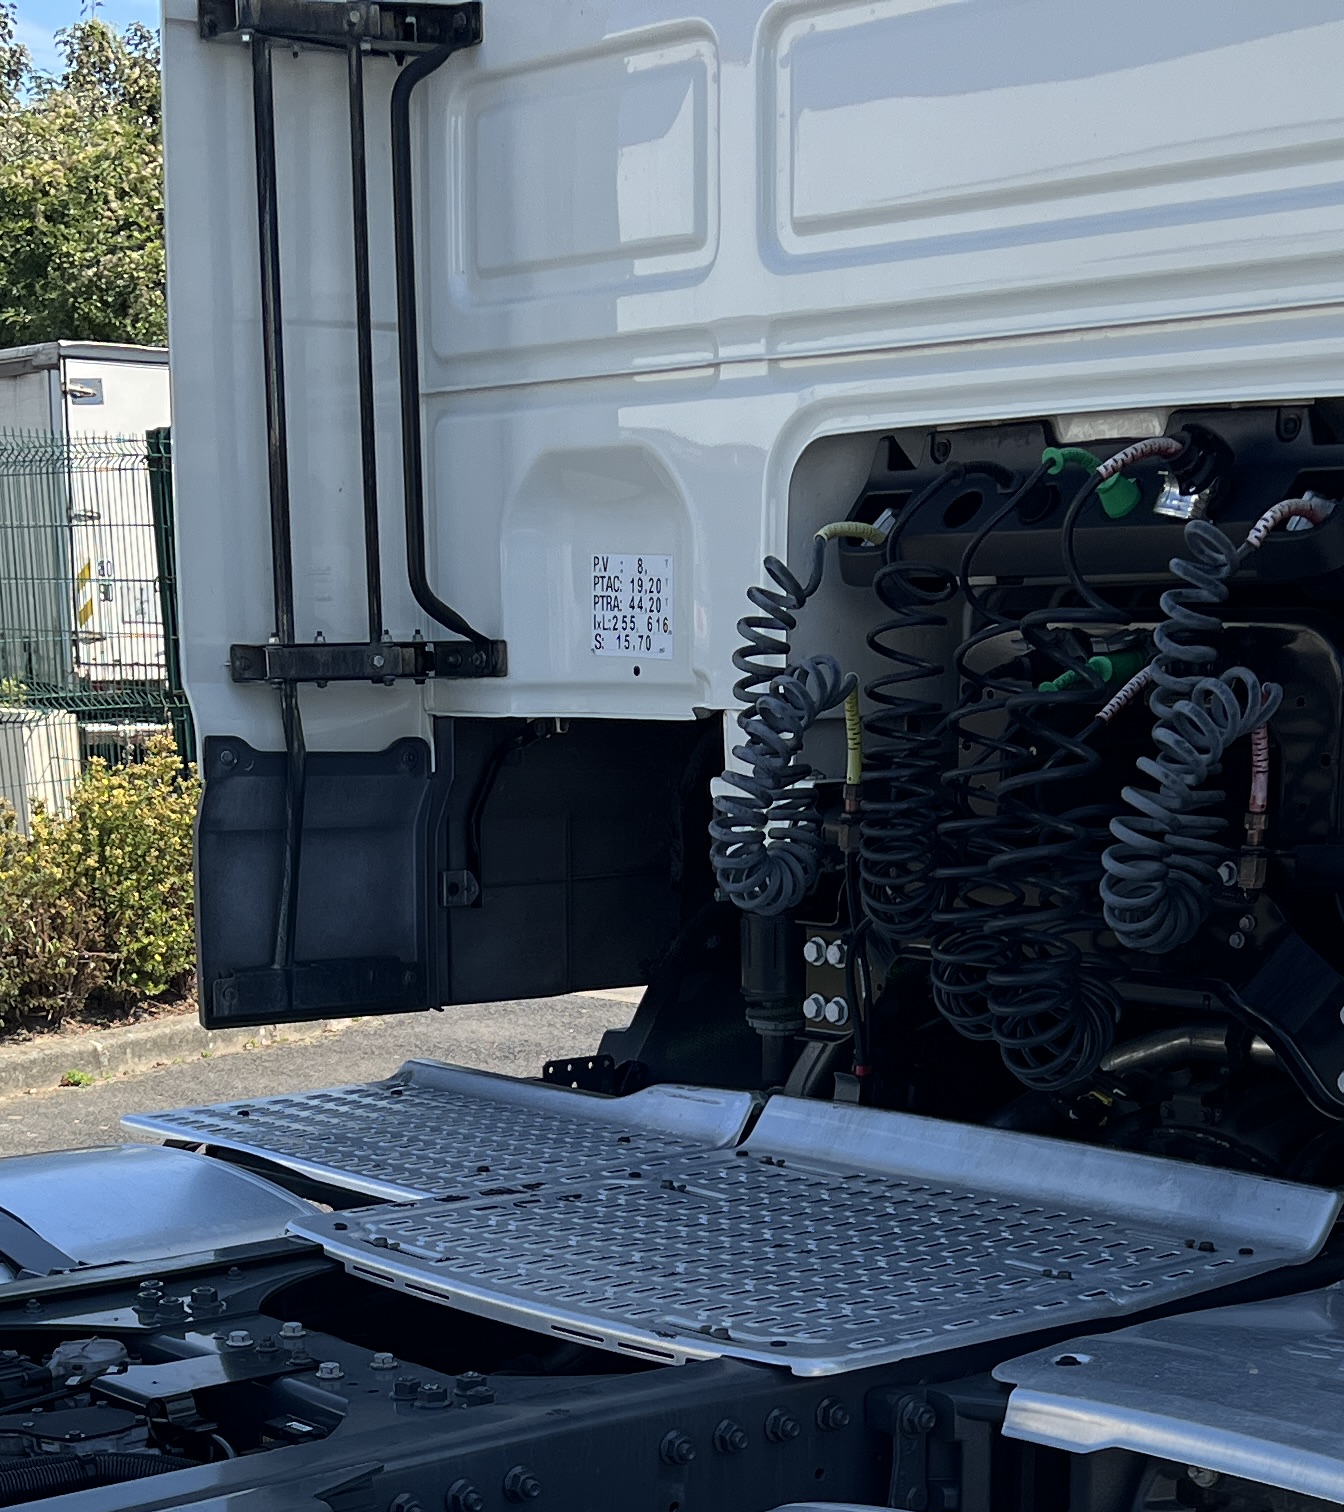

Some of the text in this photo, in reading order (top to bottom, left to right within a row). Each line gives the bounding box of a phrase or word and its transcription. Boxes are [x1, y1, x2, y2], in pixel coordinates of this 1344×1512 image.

[593, 575, 623, 593] PTAC:
[630, 577, 662, 595] 19,20
[593, 594, 623, 612] PTRA:
[628, 596, 662, 614] 44,20
[616, 633, 652, 652] 15,70
